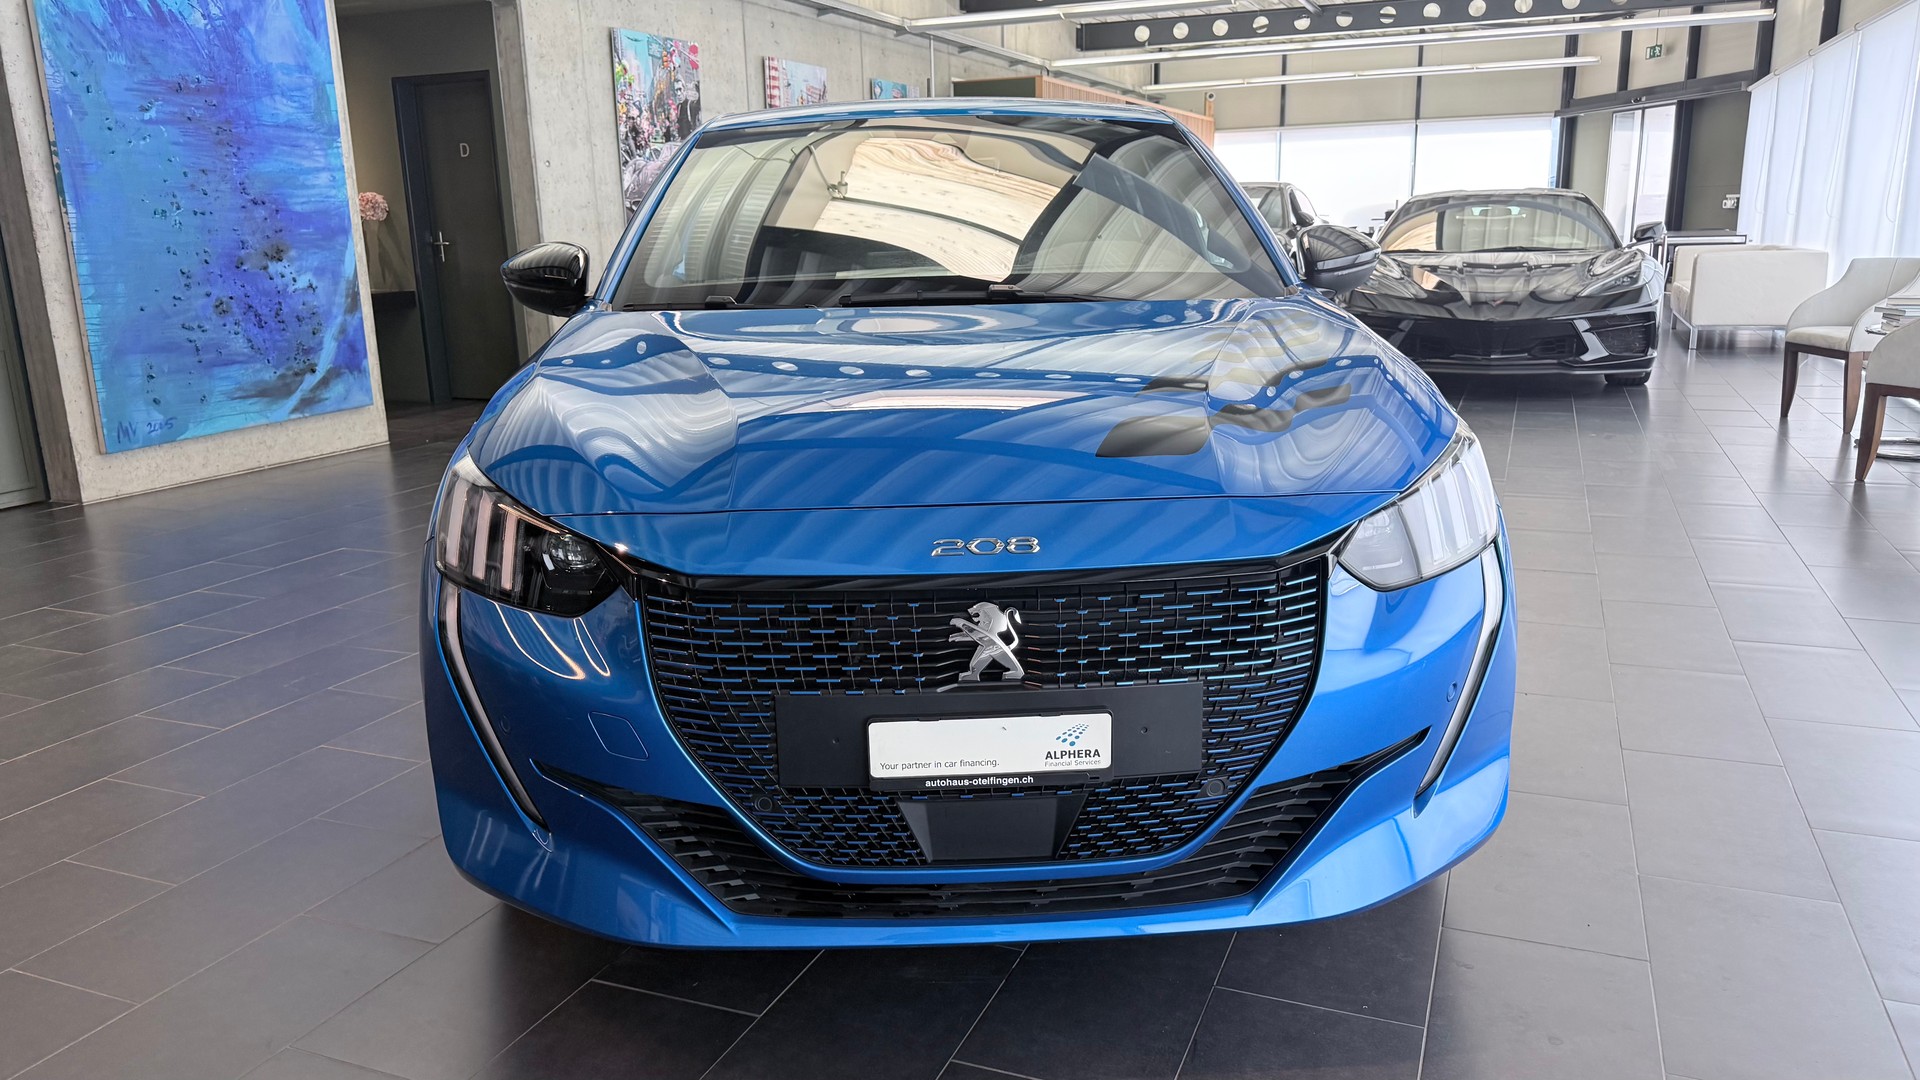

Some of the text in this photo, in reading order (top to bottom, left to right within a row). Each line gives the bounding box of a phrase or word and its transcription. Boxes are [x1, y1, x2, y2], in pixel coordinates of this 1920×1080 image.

[460, 142, 470, 158] D
[146, 416, 178, 435] 2005
[931, 536, 1041, 557] 208
[1045, 749, 1101, 760] ALPHERA
[879, 758, 1000, 771] Your partner in car financing.
[1044, 760, 1073, 768] Financial
[925, 775, 1034, 787] autohaus-otelfingen.ch
